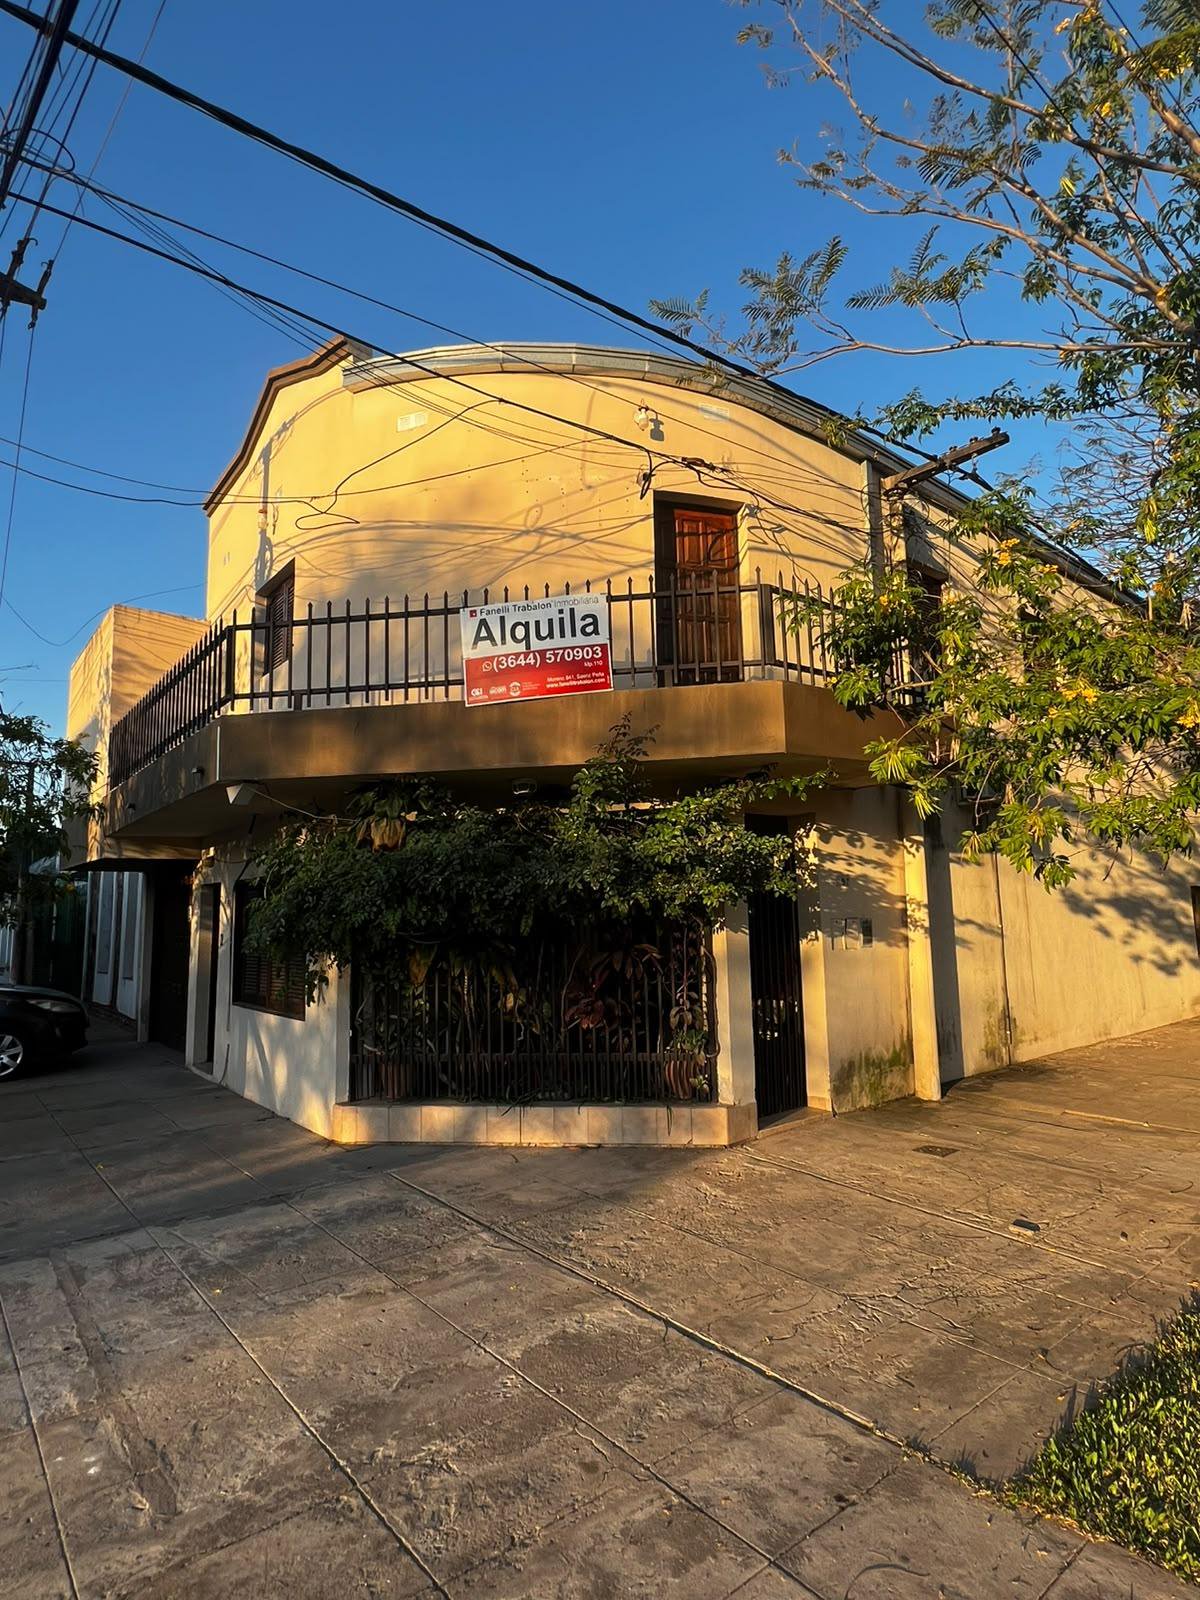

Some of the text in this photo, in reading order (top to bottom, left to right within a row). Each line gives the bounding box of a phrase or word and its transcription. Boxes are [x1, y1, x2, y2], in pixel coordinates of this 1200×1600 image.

[479, 596, 599, 617] Fanelli Trabalon Inmobiliaria
[471, 607, 601, 651] Alquila
[493, 646, 602, 673] (3644) 570903
